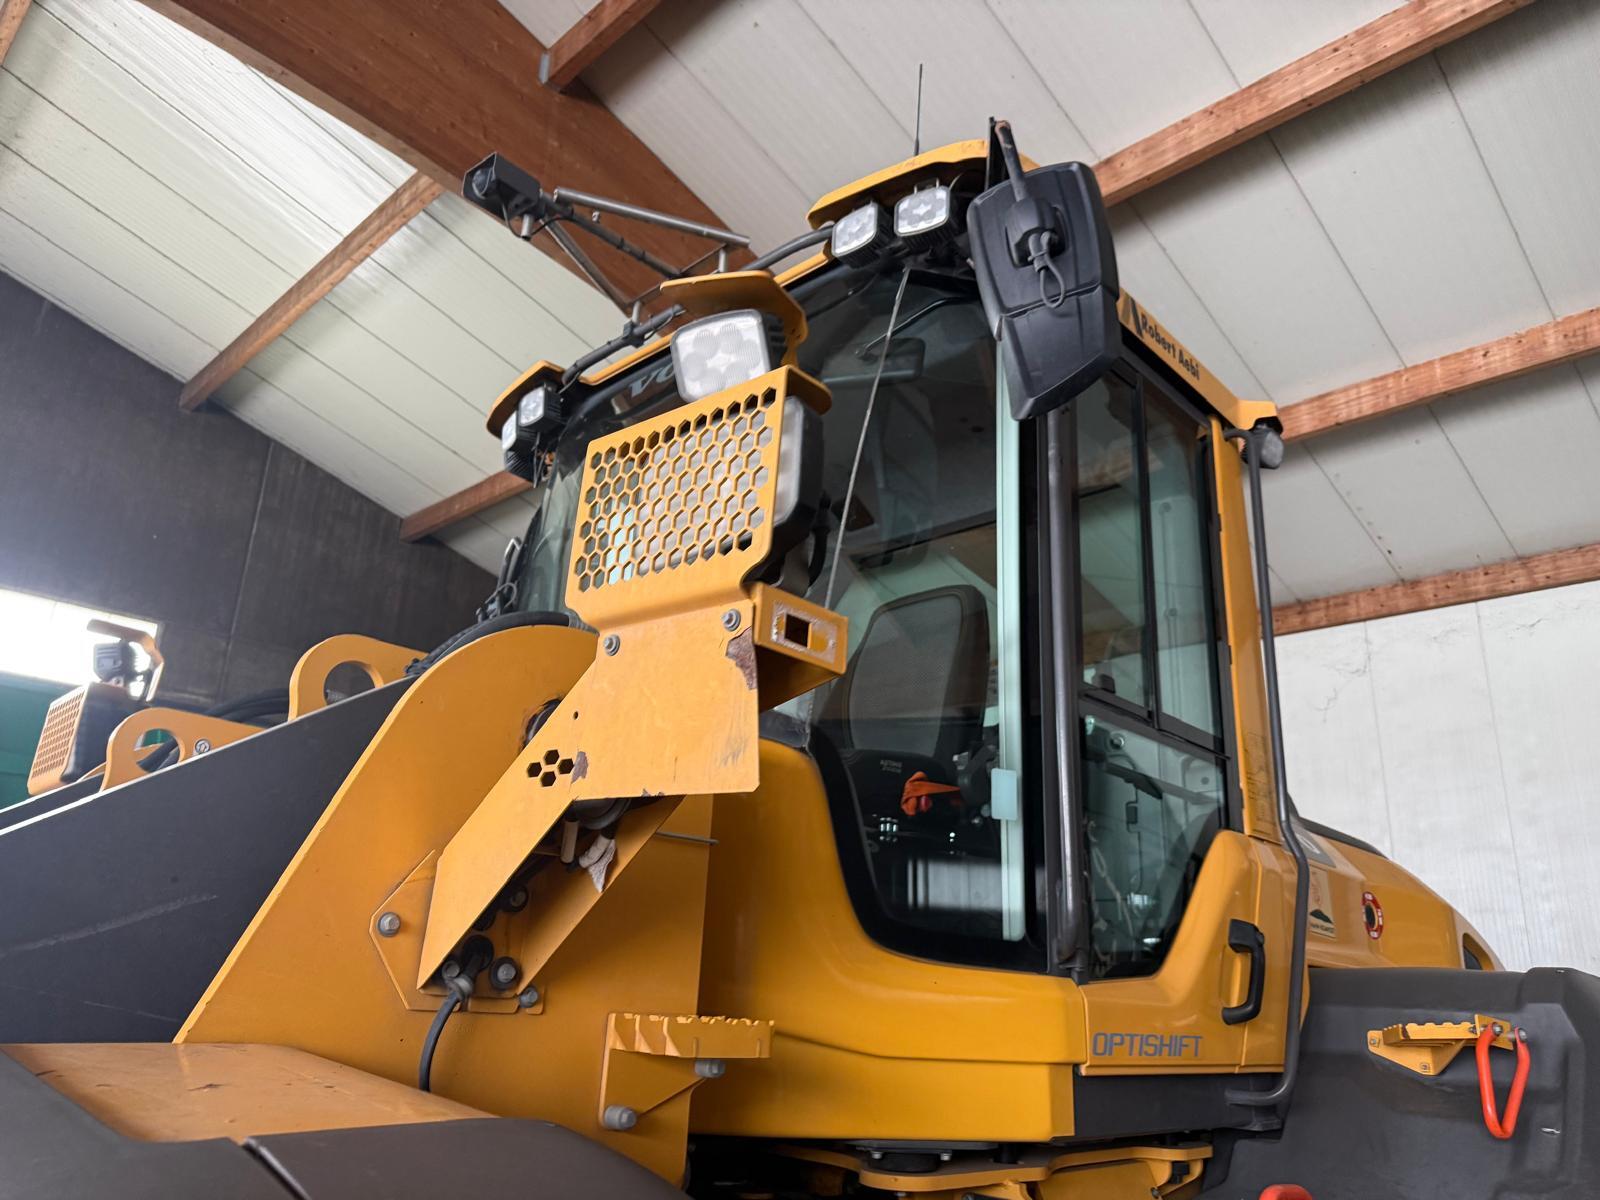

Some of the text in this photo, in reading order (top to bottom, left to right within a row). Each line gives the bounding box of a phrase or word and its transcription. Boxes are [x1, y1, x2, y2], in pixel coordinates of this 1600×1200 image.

[1141, 313, 1200, 380] Robert Aebi
[1092, 1032, 1203, 1057] OPTISHIFT
